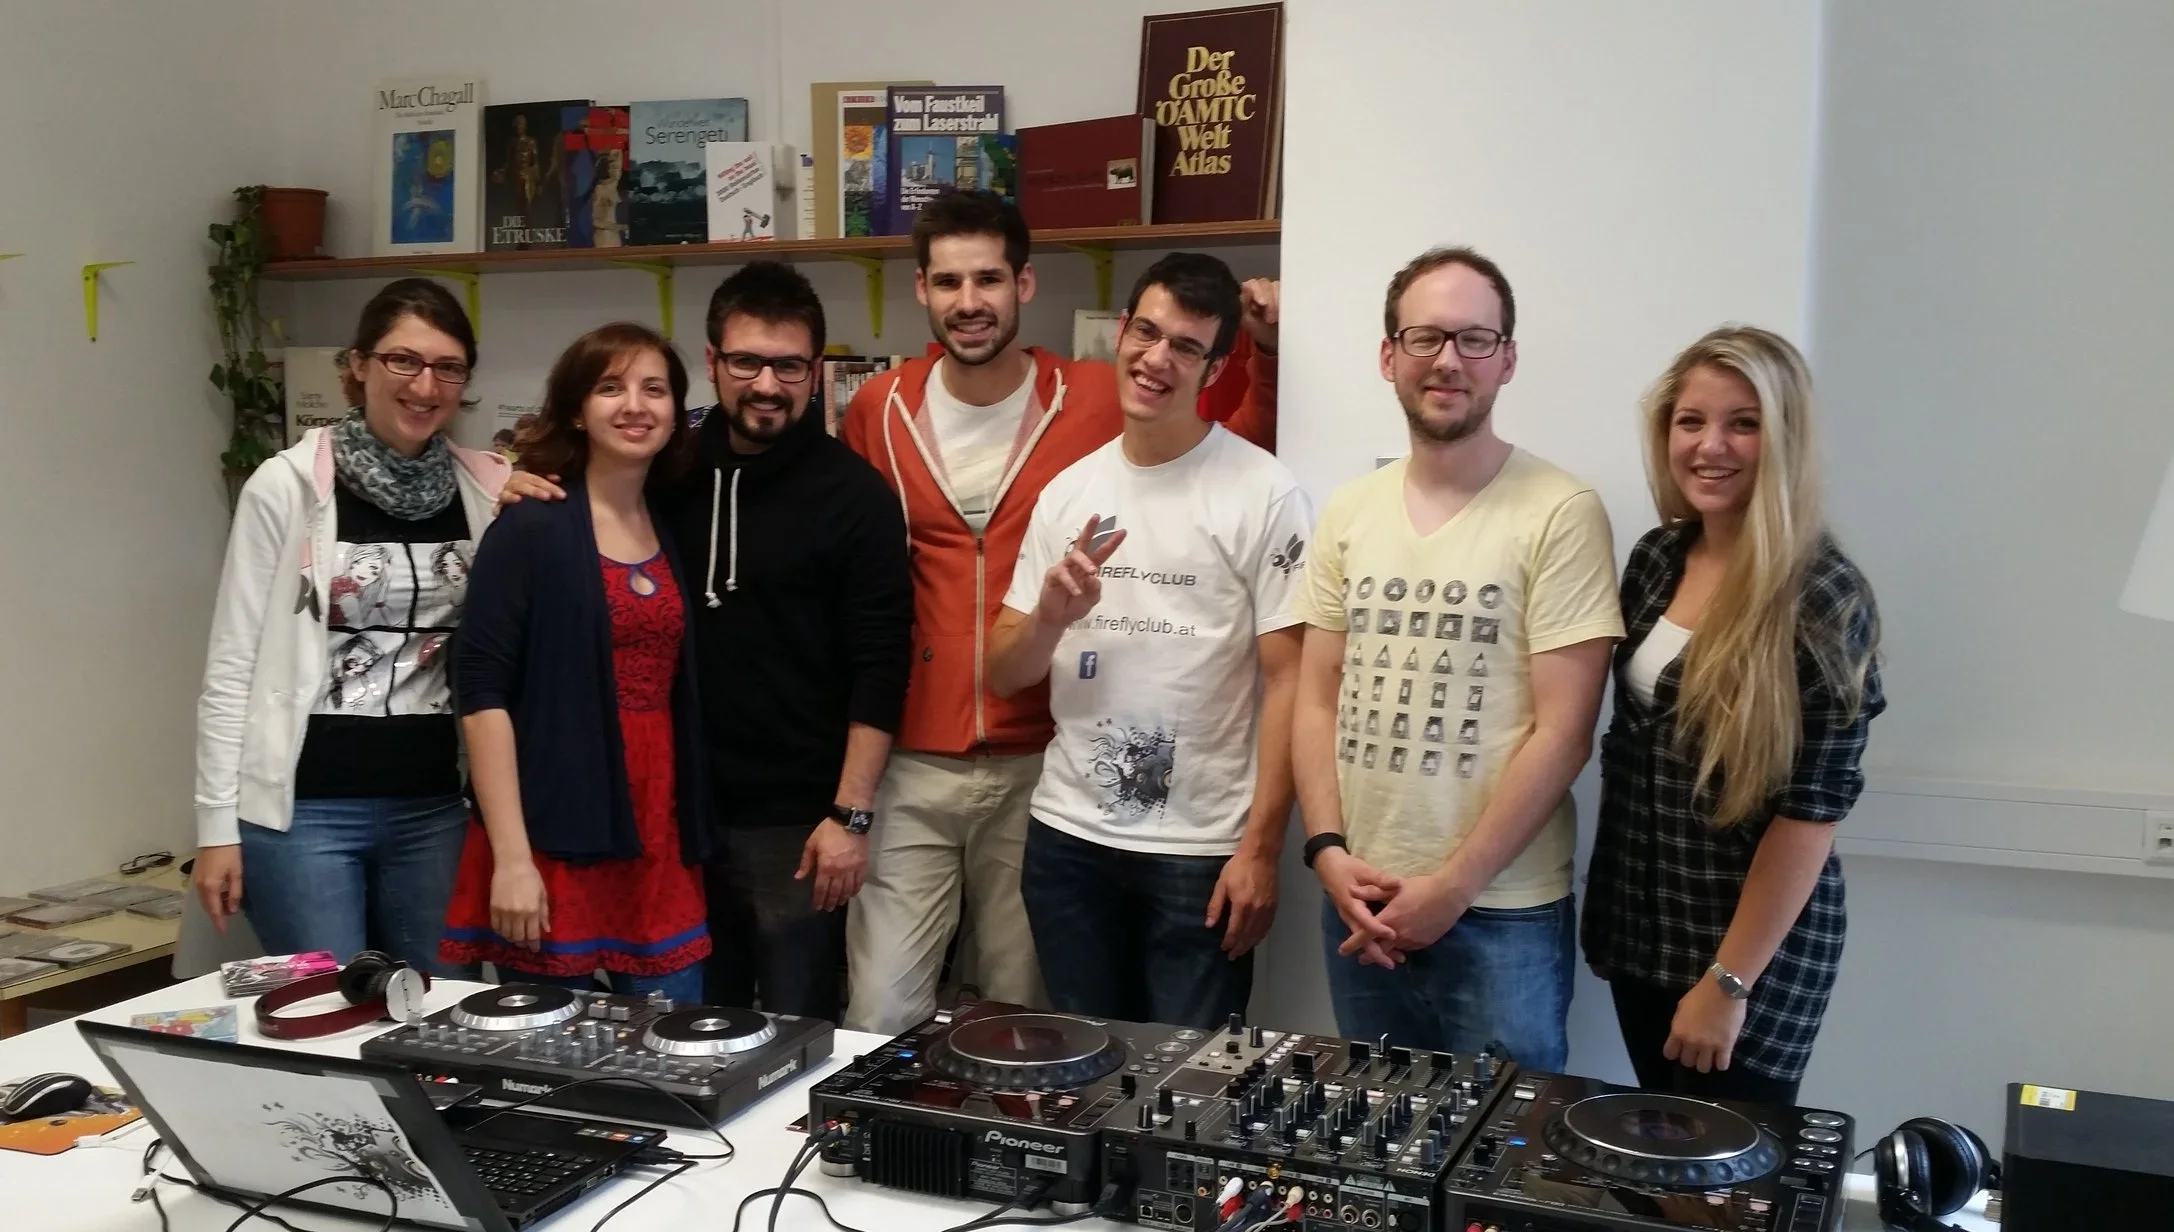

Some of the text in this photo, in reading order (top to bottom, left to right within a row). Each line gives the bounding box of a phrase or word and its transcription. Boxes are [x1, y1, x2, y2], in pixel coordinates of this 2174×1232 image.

[1186, 46, 1235, 73] Der
[1168, 70, 1246, 100] Große
[378, 82, 474, 113] Marc Chagall
[893, 95, 924, 113] Vom
[925, 95, 986, 113] Faustkeil
[1155, 94, 1257, 126] ÖAMTC
[893, 114, 999, 131] zum Laserstrahl
[645, 126, 728, 149] Serengeti
[1177, 123, 1232, 150] Welt
[1168, 151, 1232, 177] Atlas
[502, 215, 526, 228] DIE
[1097, 566, 1197, 586] IREFLYCLUB
[758, 1059, 797, 1090] Numark
[502, 1078, 553, 1096] Numark
[984, 1130, 1065, 1154] Pioneer
[1396, 1167, 1436, 1178] DENON
